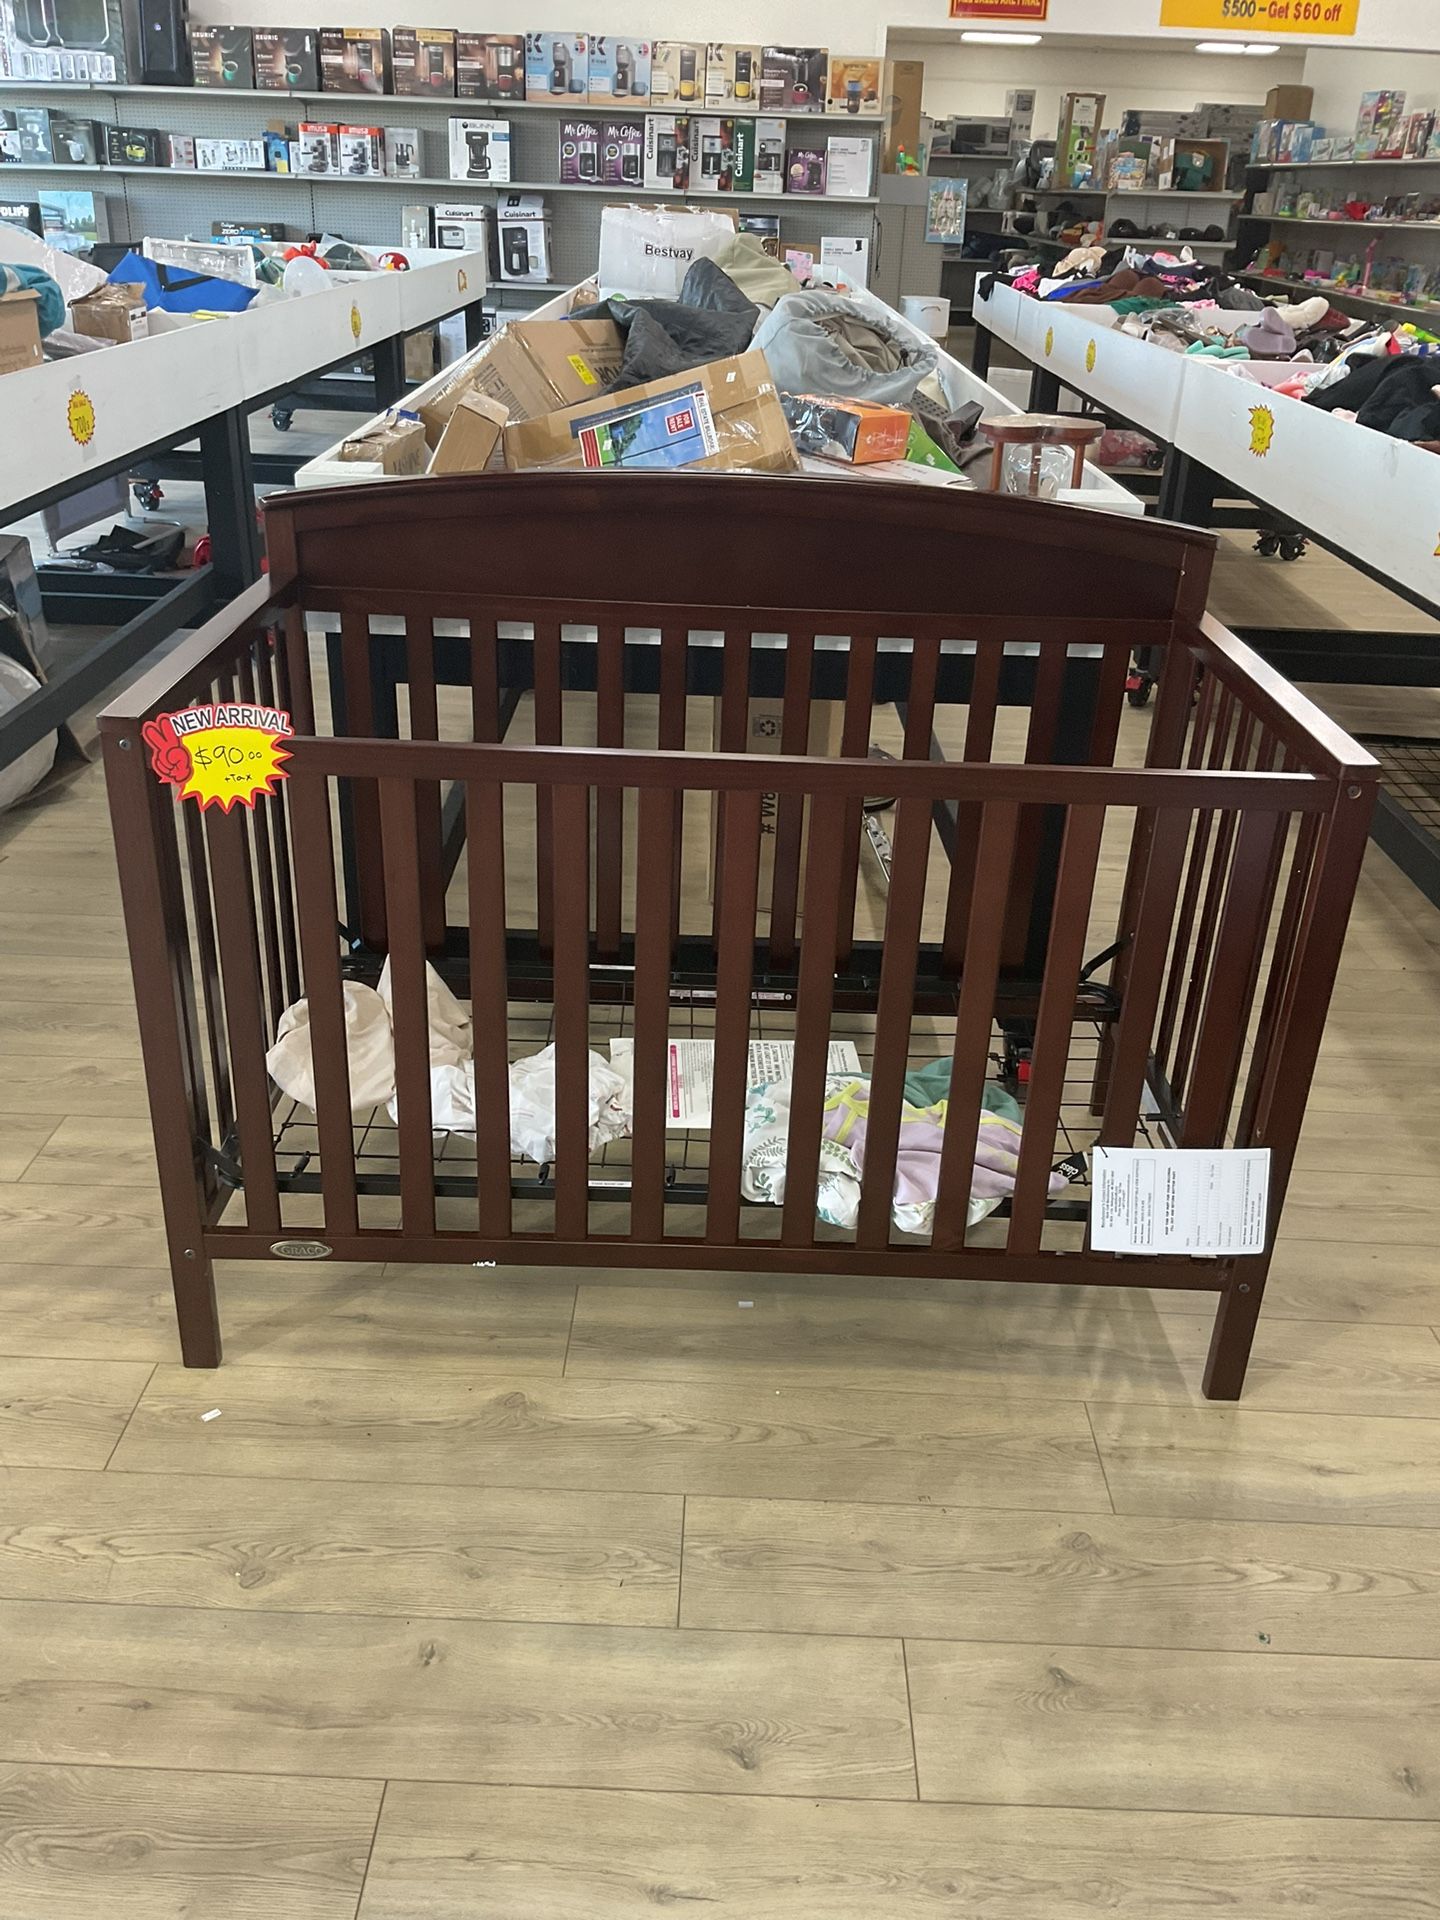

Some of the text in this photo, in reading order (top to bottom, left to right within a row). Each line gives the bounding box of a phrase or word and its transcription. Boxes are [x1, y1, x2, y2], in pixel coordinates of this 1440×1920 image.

[1293, 2, 1321, 21] $60
[1324, 4, 1342, 21] off
[646, 118, 655, 160] Cuisinart
[691, 120, 700, 162] Cuisinart
[734, 132, 744, 177] Cuisinart
[445, 209, 474, 217] Cuisinart
[504, 210, 536, 218] Cuisinart
[172, 707, 291, 734] NEW ARRIVAL
[281, 1246, 323, 1255] GRACO
